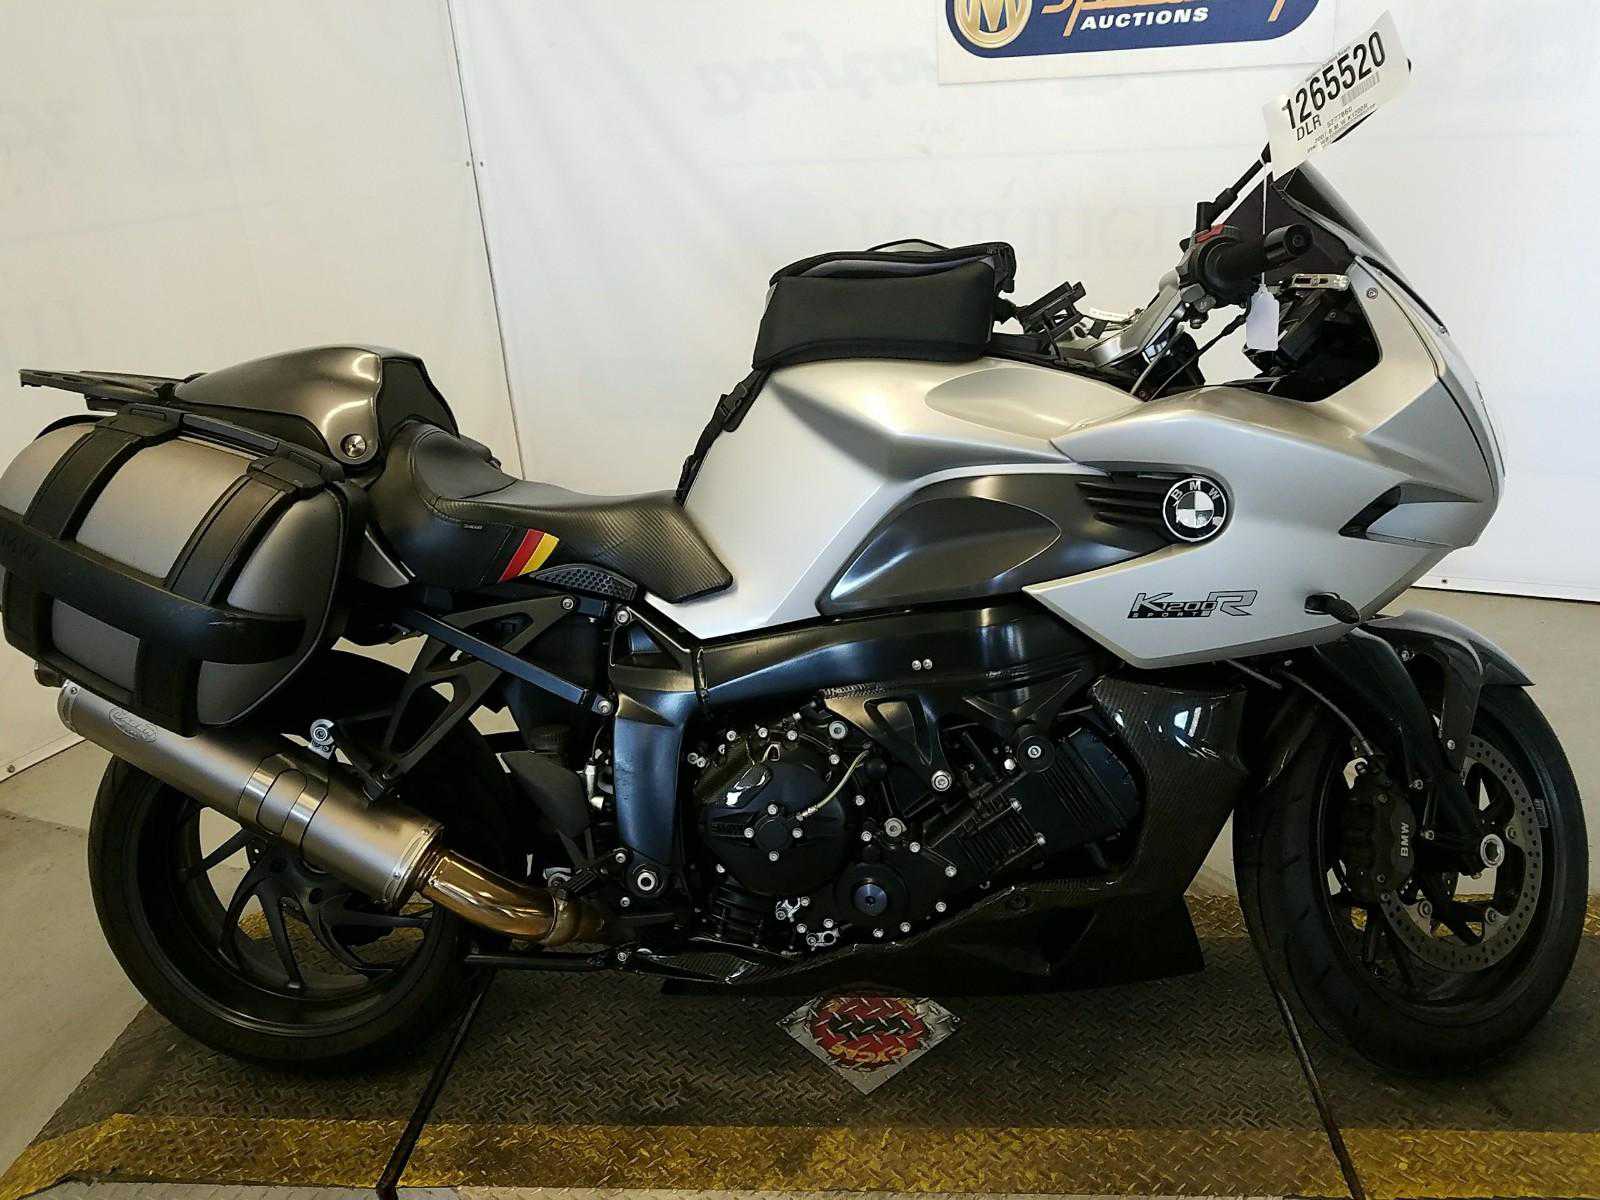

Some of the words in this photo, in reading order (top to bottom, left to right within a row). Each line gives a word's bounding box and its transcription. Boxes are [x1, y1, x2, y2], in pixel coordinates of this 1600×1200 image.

[1080, 7, 1208, 31] AUCTIONS
[1281, 31, 1386, 130] 1265520
[1296, 114, 1321, 141] DLR
[1171, 480, 1220, 501] BMW
[1400, 822, 1409, 857] BMW
